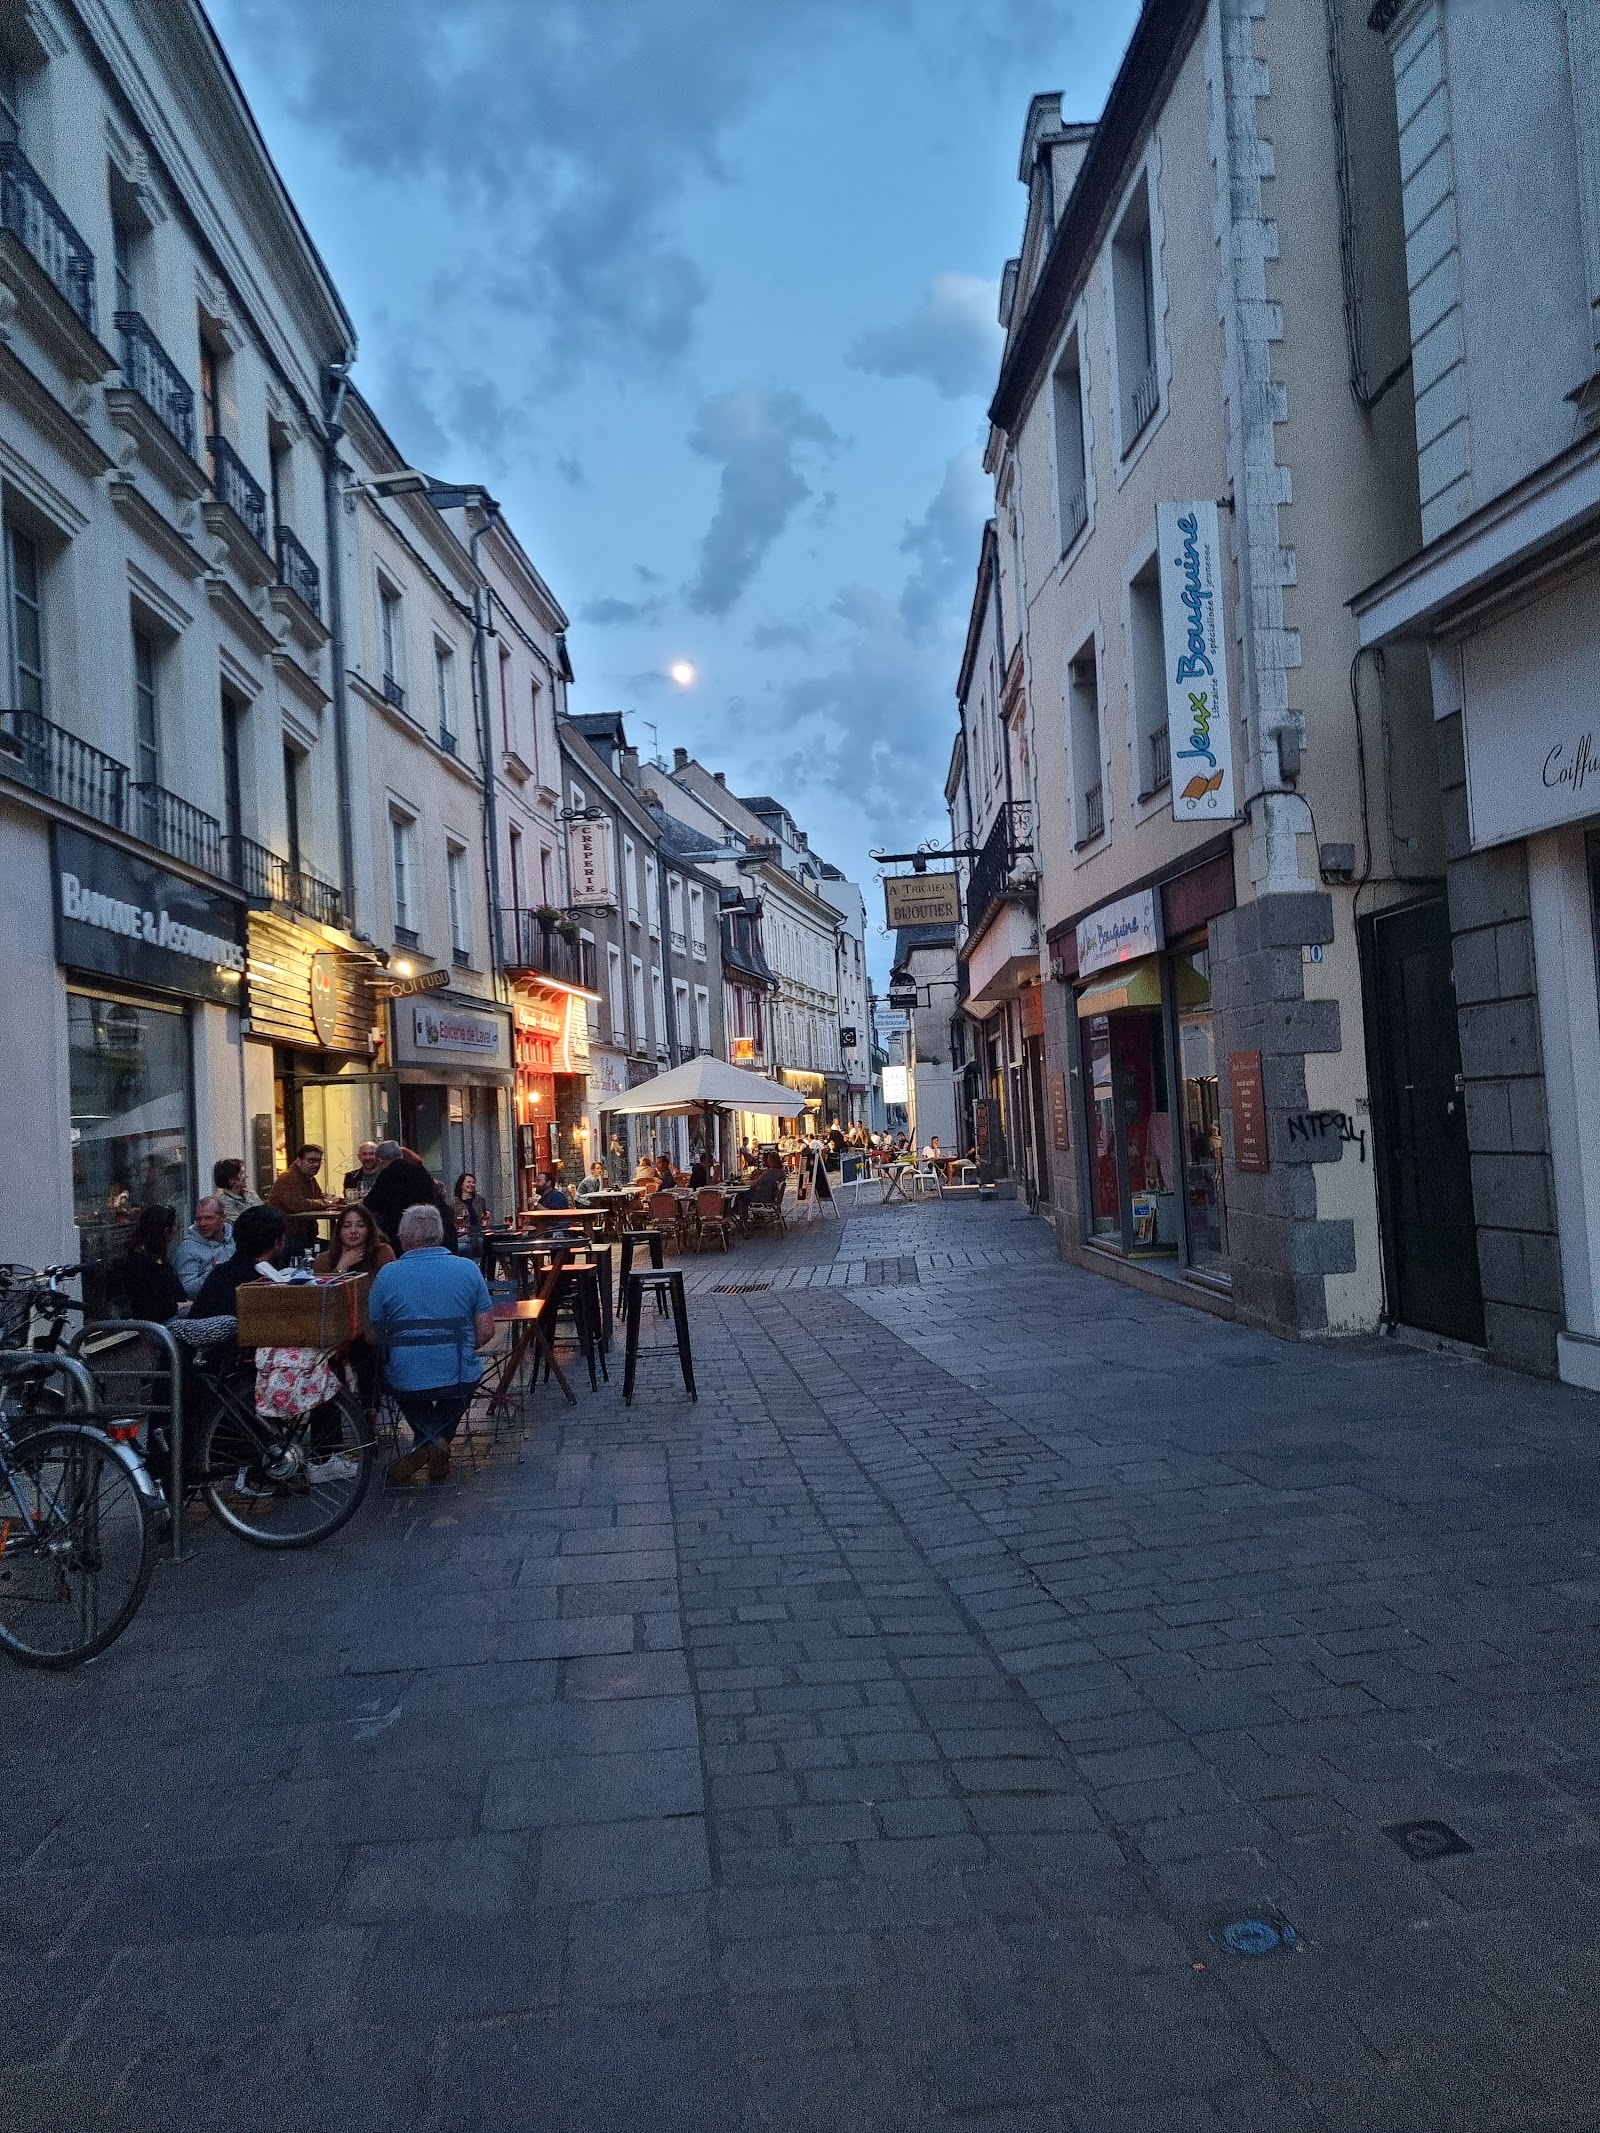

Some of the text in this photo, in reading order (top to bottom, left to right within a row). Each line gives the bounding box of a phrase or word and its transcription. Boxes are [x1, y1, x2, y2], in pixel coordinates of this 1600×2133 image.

[1174, 512, 1217, 768] Jeux Bouquine
[1542, 733, 1600, 791] Coiffu
[894, 902, 954, 920] BIJOUTIER
